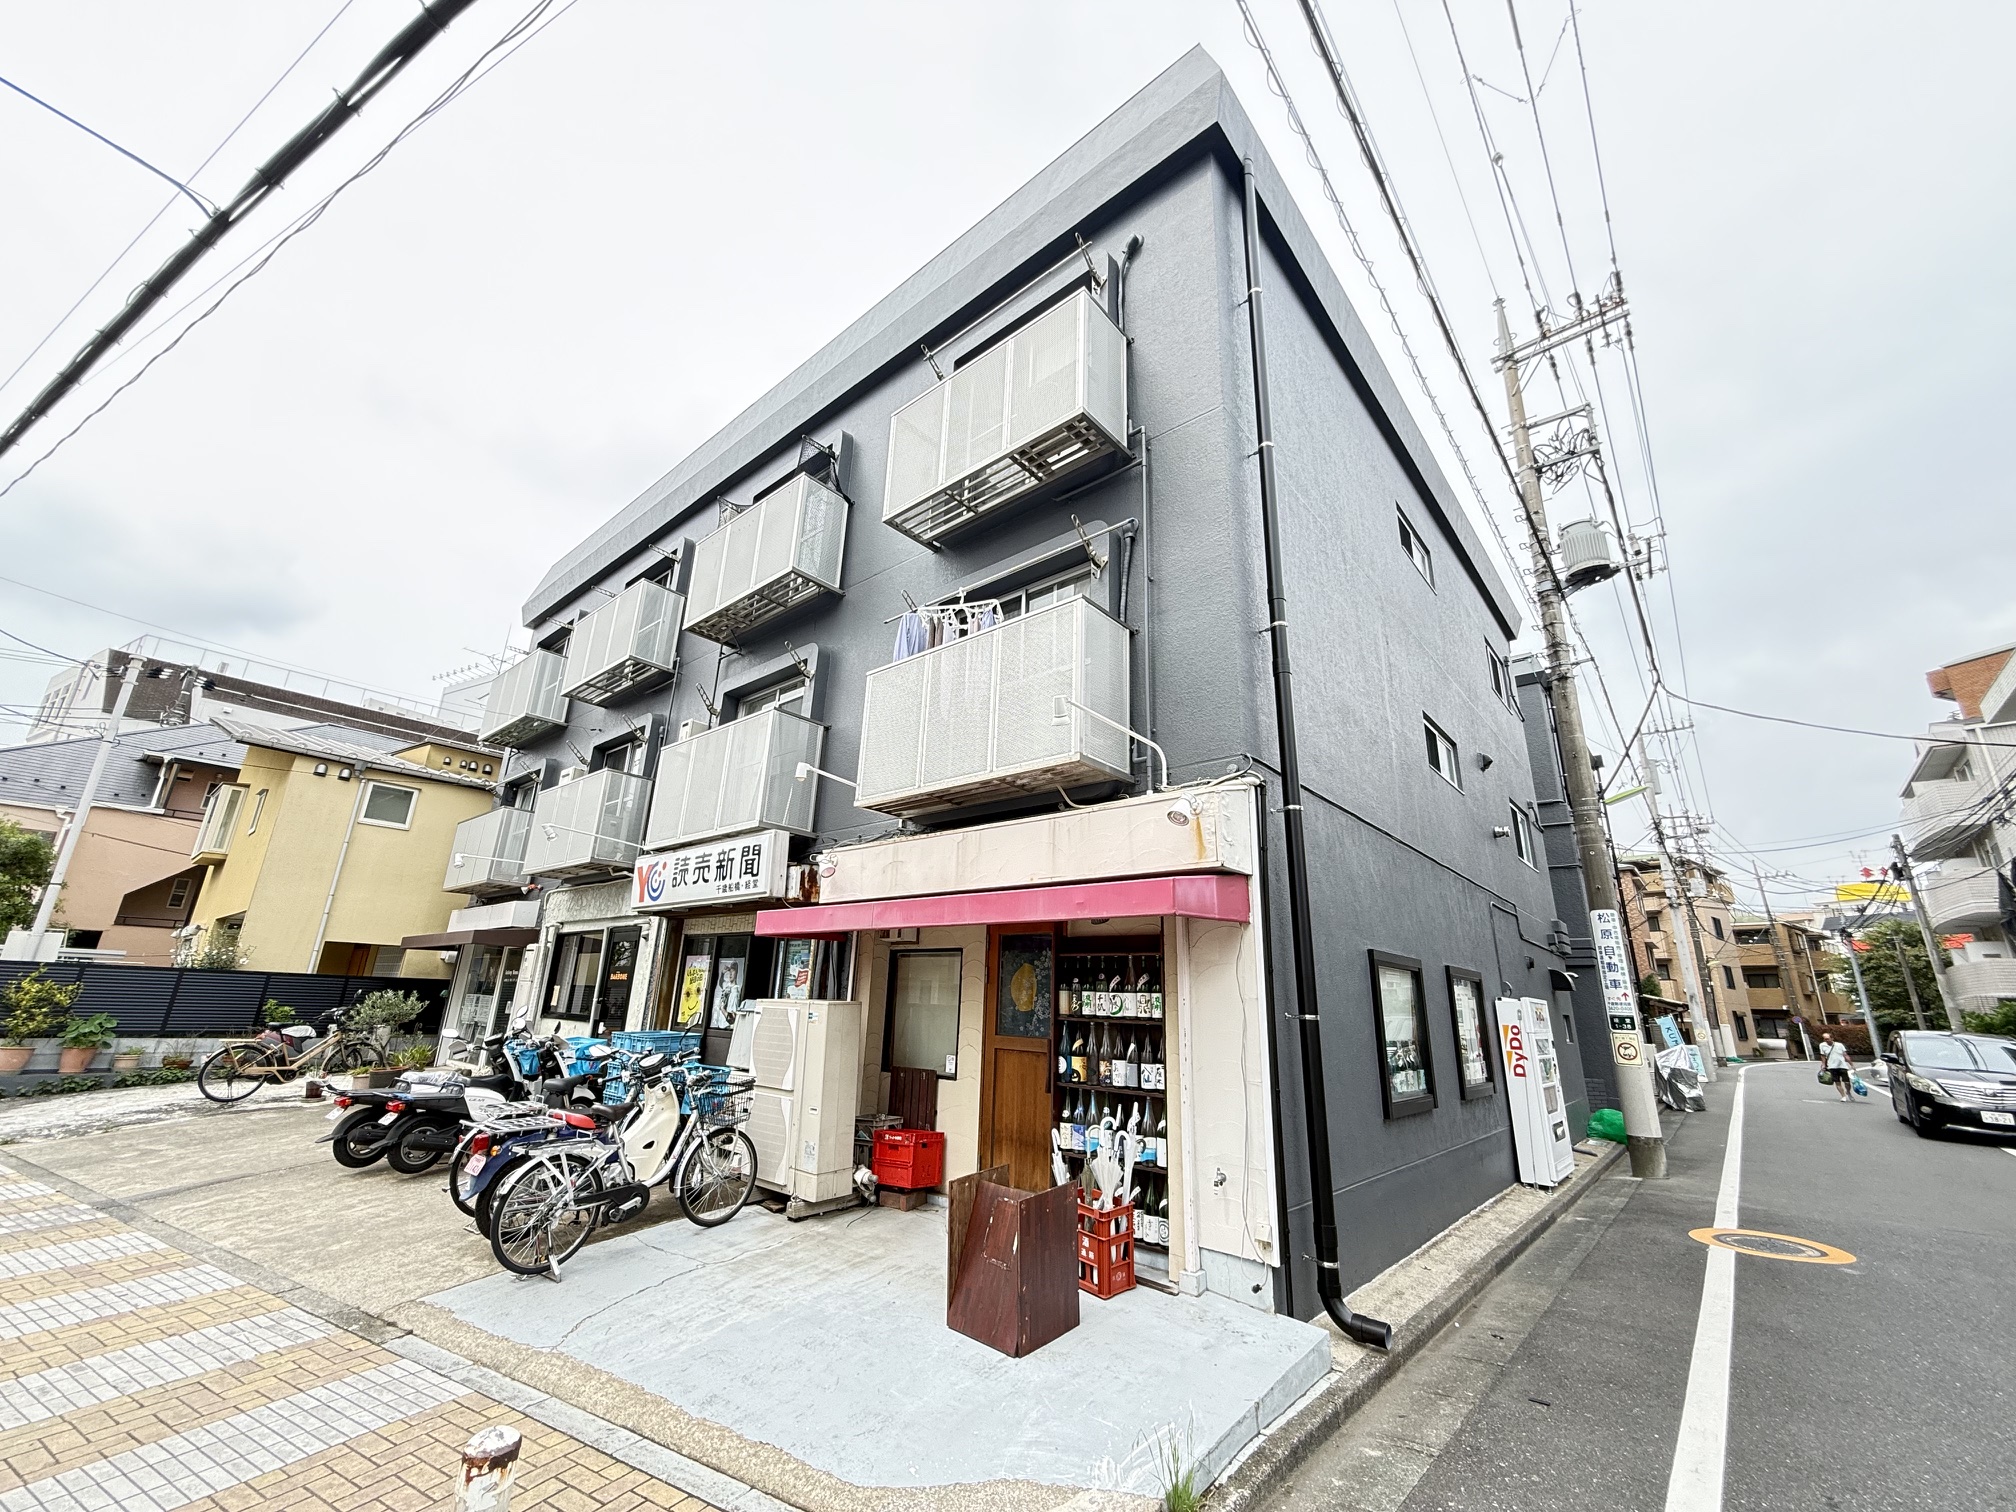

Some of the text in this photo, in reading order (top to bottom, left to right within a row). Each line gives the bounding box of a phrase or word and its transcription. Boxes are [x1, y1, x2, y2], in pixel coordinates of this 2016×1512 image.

[671, 844, 762, 888] 読売新聞
[1597, 912, 1622, 989] 松原自動車
[1509, 1025, 1528, 1077] DyDo
